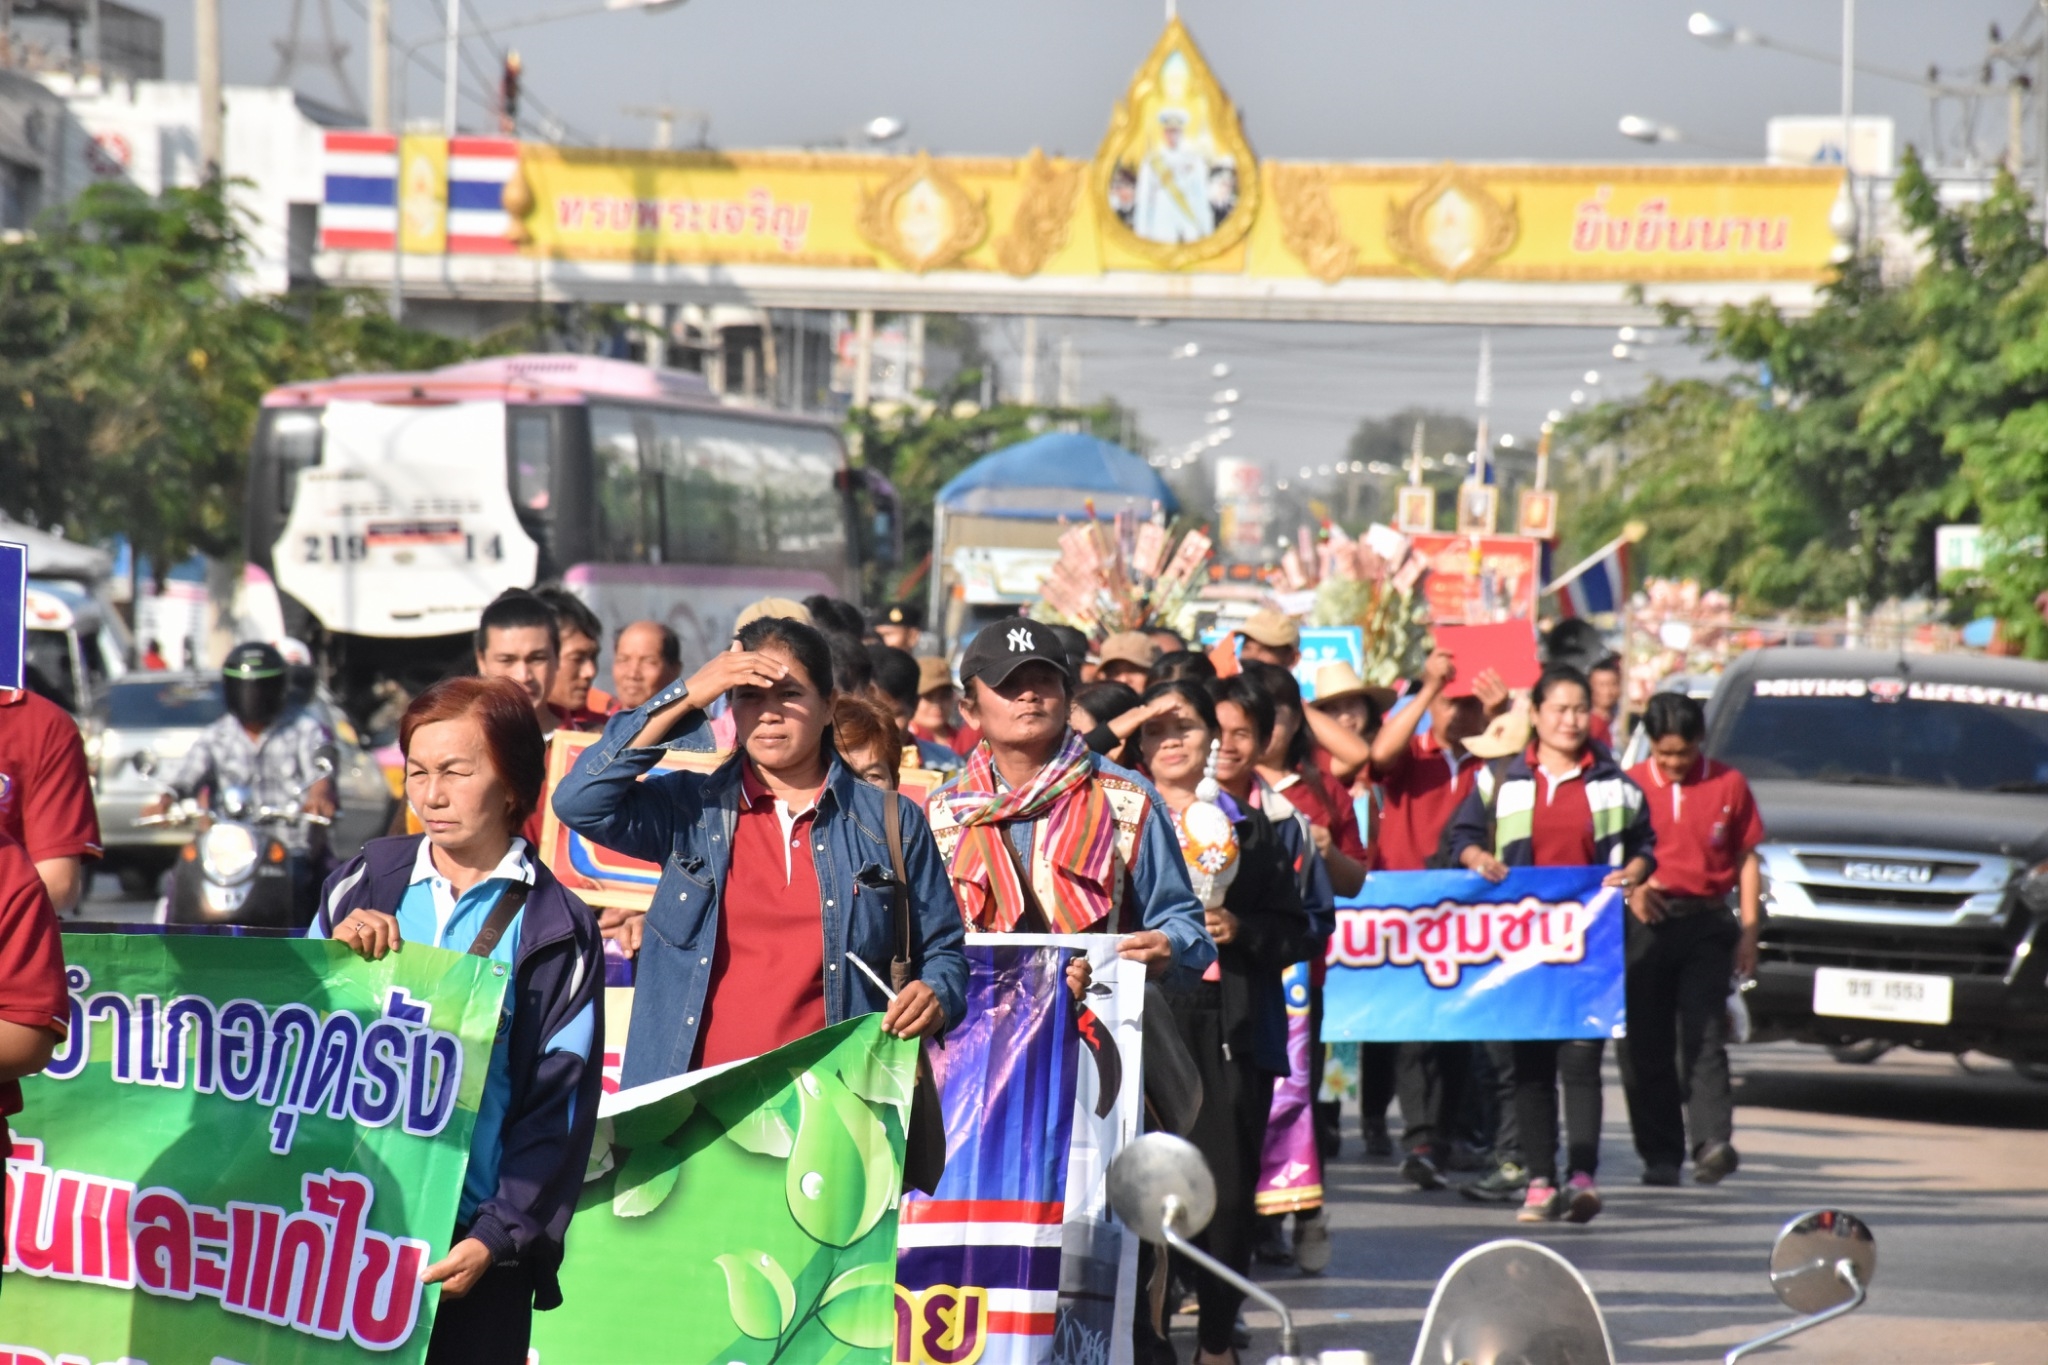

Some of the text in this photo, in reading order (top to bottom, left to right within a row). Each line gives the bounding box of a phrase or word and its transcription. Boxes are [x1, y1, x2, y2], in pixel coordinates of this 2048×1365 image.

[1573, 185, 1788, 254] ยิ่งยืนนาน
[1754, 679, 1868, 698] DRIVING
[1844, 861, 1932, 884] ISUZU
[1, 1142, 426, 1347] ันและแก้ไข
